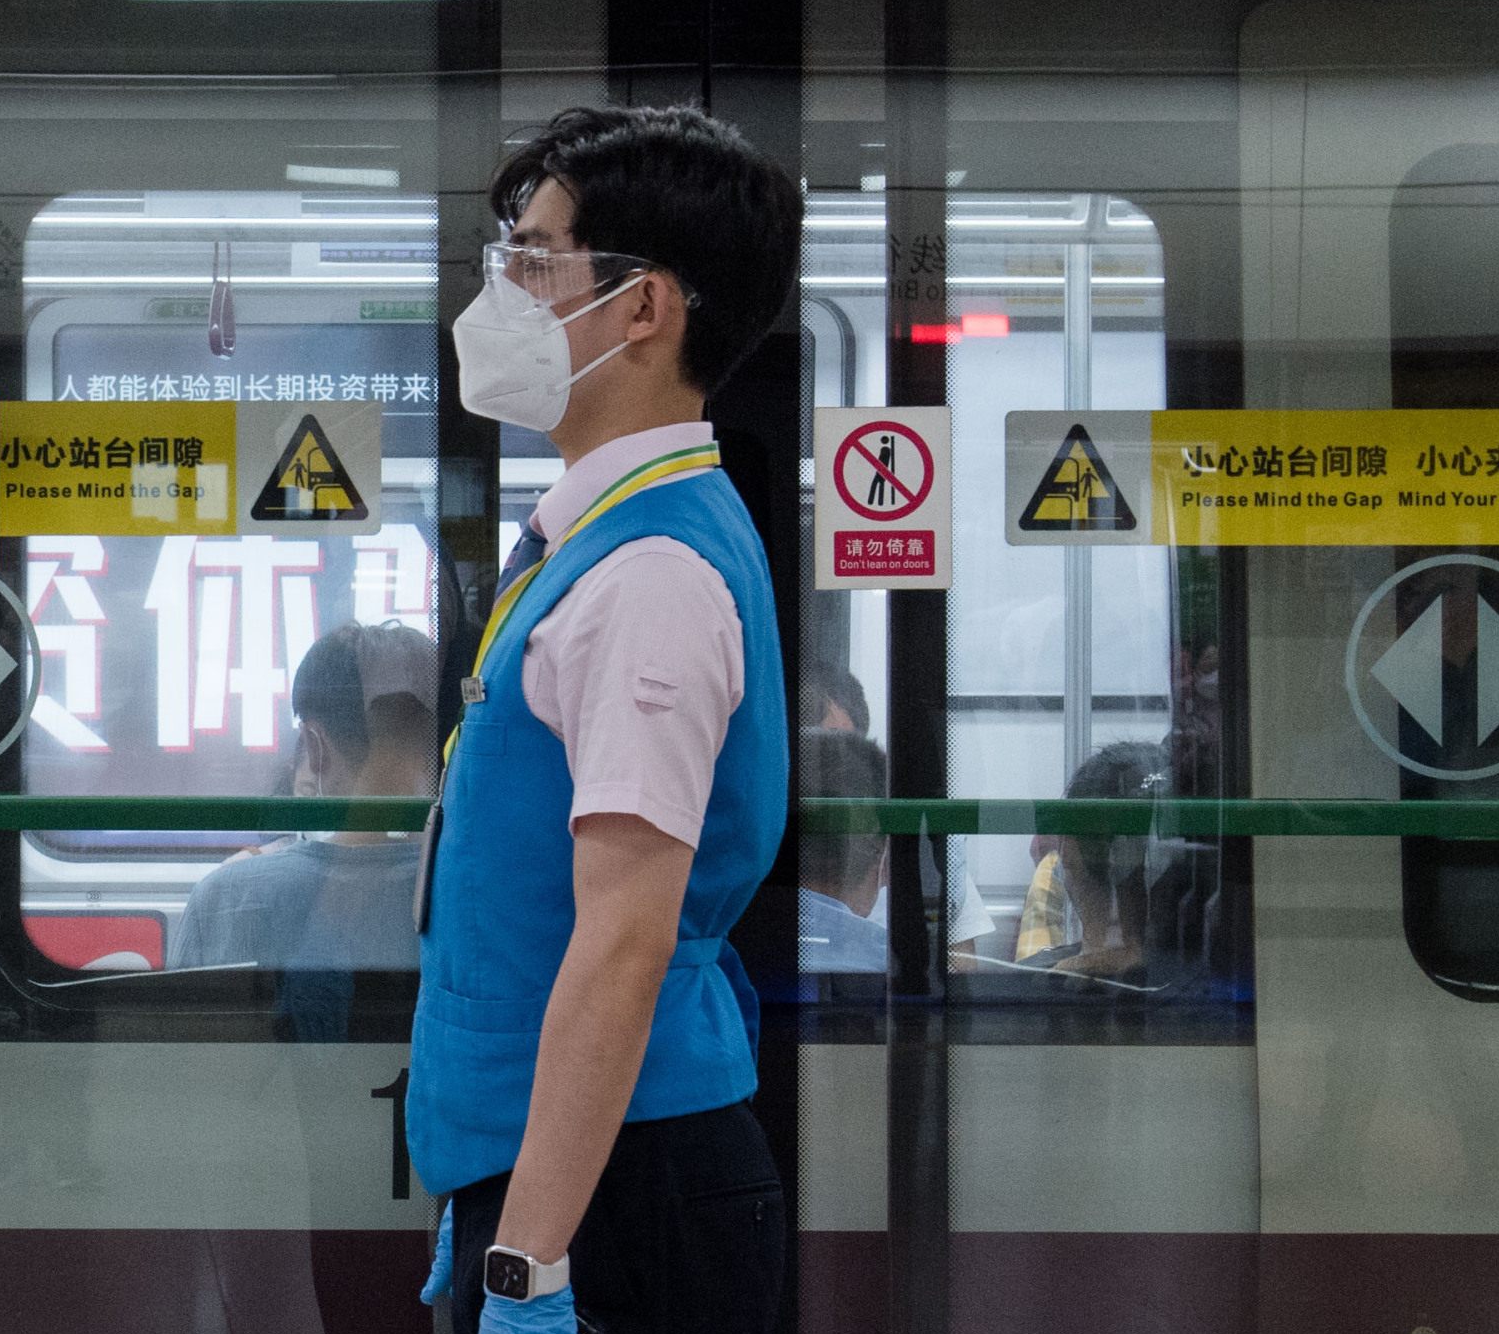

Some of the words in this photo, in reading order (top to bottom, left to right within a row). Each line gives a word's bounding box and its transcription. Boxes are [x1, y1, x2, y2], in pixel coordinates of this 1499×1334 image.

[57, 372, 432, 403] 人都能体验到长期投资带来
[0, 436, 205, 470] 小心站台间隙
[1183, 444, 1389, 478] 小心站台间隙
[5, 482, 73, 500] Please
[76, 482, 126, 500] Mind
[129, 482, 163, 500] the
[165, 482, 207, 505] Gap
[1182, 491, 1249, 508] Please
[1253, 491, 1304, 508] Mind
[1307, 491, 1339, 508] the
[1342, 491, 1384, 512] Gap
[1397, 490, 1447, 507] Mind
[1450, 490, 1499, 507] Your
[845, 538, 925, 557] 请勿倚靠
[839, 559, 866, 570] Don't
[867, 559, 888, 570] lean
[889, 560, 902, 570] on
[903, 559, 930, 570] doors
